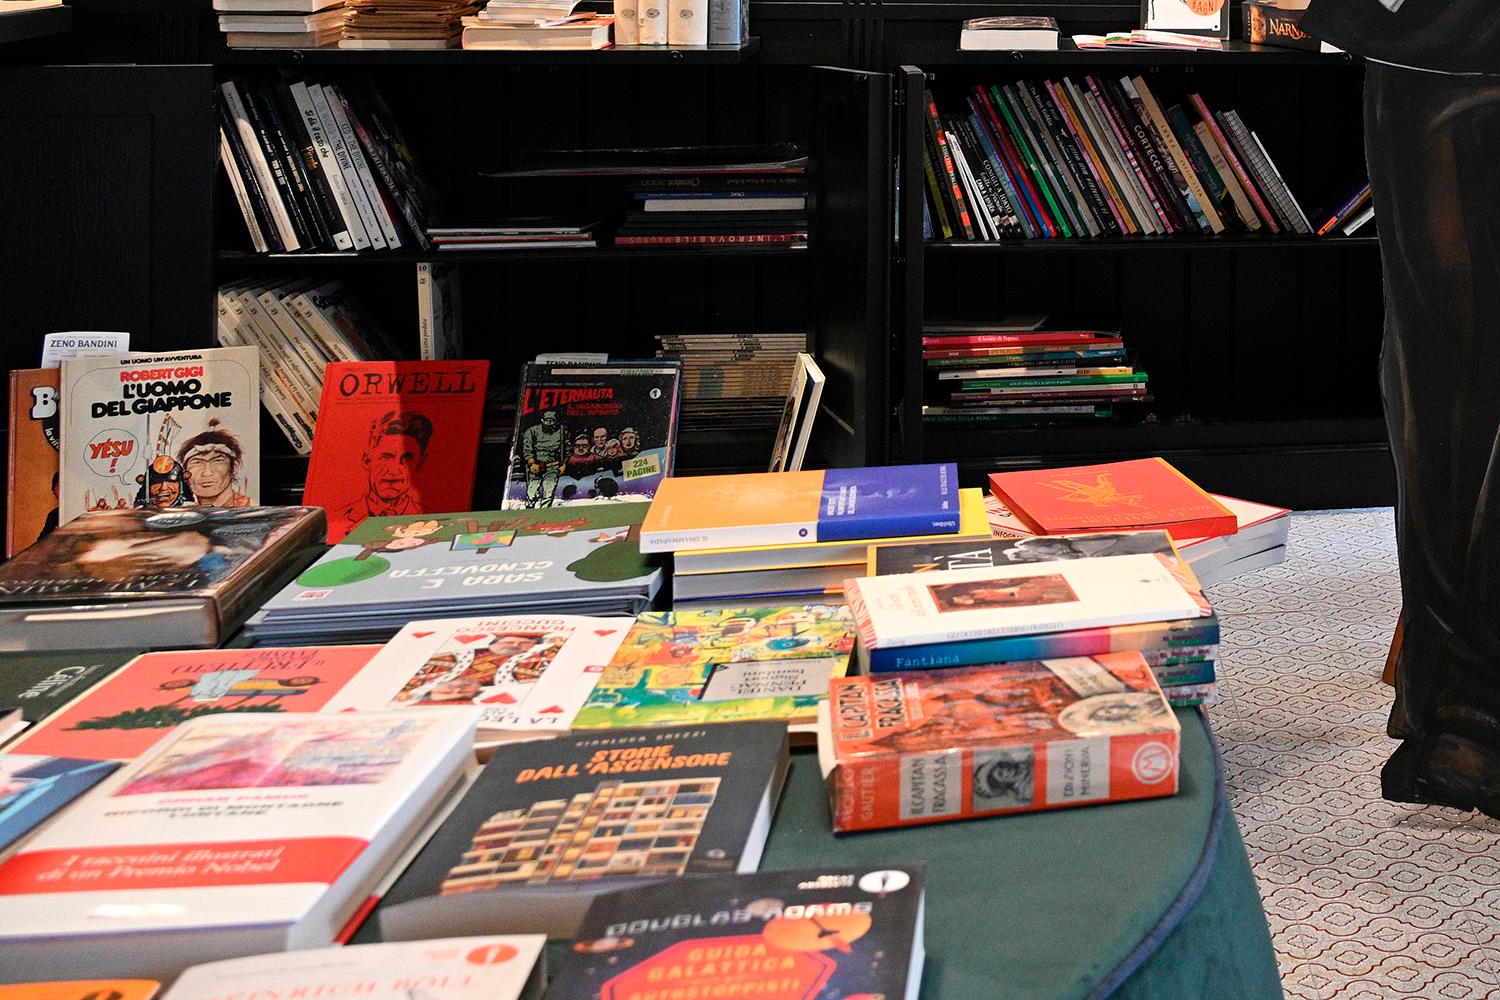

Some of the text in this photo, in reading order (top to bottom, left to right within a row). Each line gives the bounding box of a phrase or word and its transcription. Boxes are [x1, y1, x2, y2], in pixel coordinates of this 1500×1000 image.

[1132, 122, 1164, 174] CORTECCE
[352, 151, 367, 170] DIVINE
[674, 235, 790, 245] L'INTROVABILE
[50, 338, 118, 348] ZENO BANDINI
[152, 354, 203, 364] UN'AVVENTURA
[119, 366, 203, 382] ROBERT GIGI
[339, 370, 477, 397] ORWELL
[123, 378, 201, 399] L'UOMO
[91, 392, 232, 419] DEL GIAPPONE
[521, 387, 615, 417] L'ETERNAUTA
[89, 438, 134, 461] YÉSU
[626, 465, 657, 478] PAGINE
[632, 458, 649, 468] 224
[649, 536, 700, 545] DHAMMAPADA
[388, 560, 555, 580] GENOVEFFA
[420, 570, 545, 589] SARA E
[455, 623, 577, 634] FRANCESCO
[477, 619, 566, 627] GUCCINI
[895, 654, 960, 668] Fantiana
[17, 664, 88, 699] Céline
[738, 685, 801, 695] DANIEL
[838, 682, 868, 728] CAPITAN
[872, 677, 906, 729] FRACASSA
[528, 716, 558, 725] LA
[842, 729, 869, 741] IL
[590, 744, 673, 763] STORIE
[515, 751, 732, 783] DALL'ASCENSORE
[1062, 748, 1075, 798] EDIZIONI
[911, 757, 926, 806] CAPITAN
[932, 755, 948, 814] FRACASSA
[861, 767, 876, 820] GAUTIER
[103, 805, 194, 817] RICORDI
[226, 801, 345, 810] MONTAGNE
[64, 844, 286, 867] I taccuini illustrati
[37, 858, 282, 882] di un Premio Nobel
[605, 902, 873, 936] DOUGLAS ADAMS
[687, 941, 767, 961] GUIDA
[646, 957, 796, 981] GALATTICA
[628, 978, 800, 1000] AUTOSTOPPISTI
